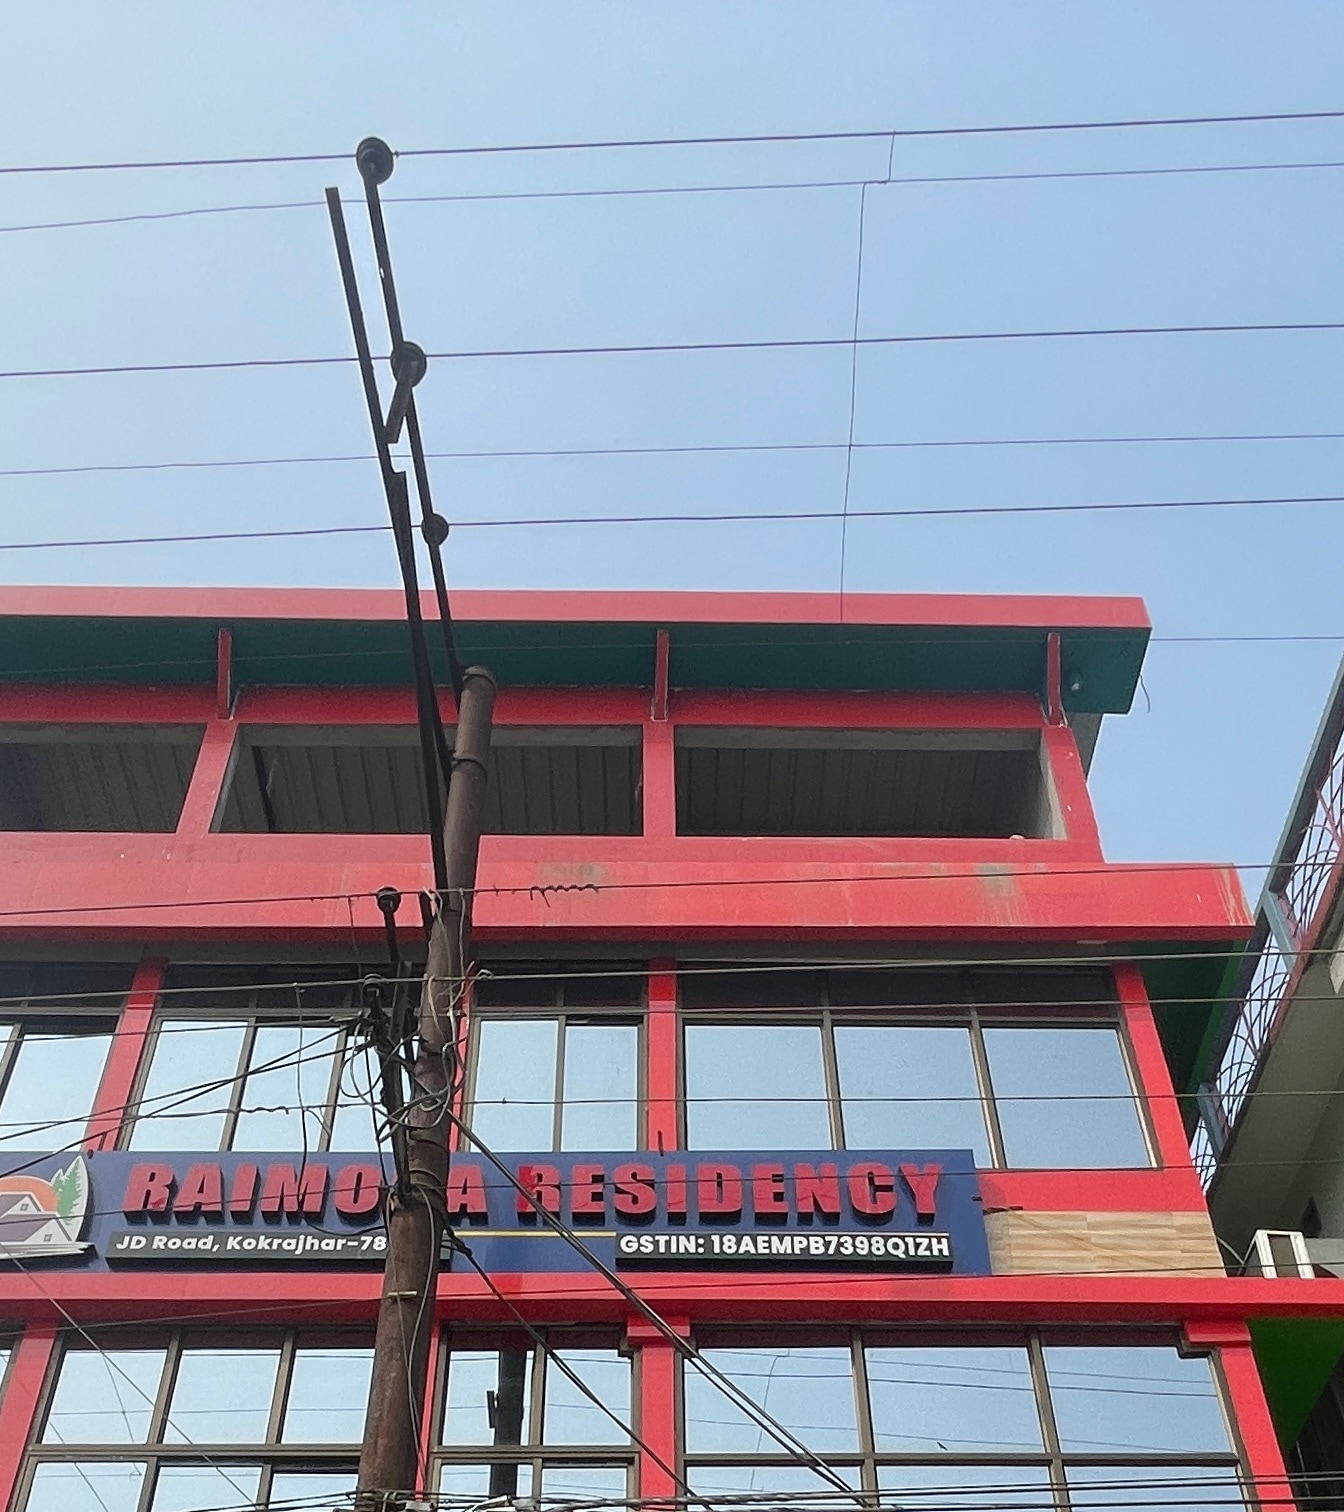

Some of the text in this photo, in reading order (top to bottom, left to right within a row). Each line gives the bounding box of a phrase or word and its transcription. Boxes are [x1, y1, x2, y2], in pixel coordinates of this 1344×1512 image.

[124, 1162, 943, 1216] RAIMOA RESIDENCY
[115, 1235, 149, 1251] JD
[152, 1234, 221, 1254] Road,
[619, 1235, 705, 1255] GSTIN:
